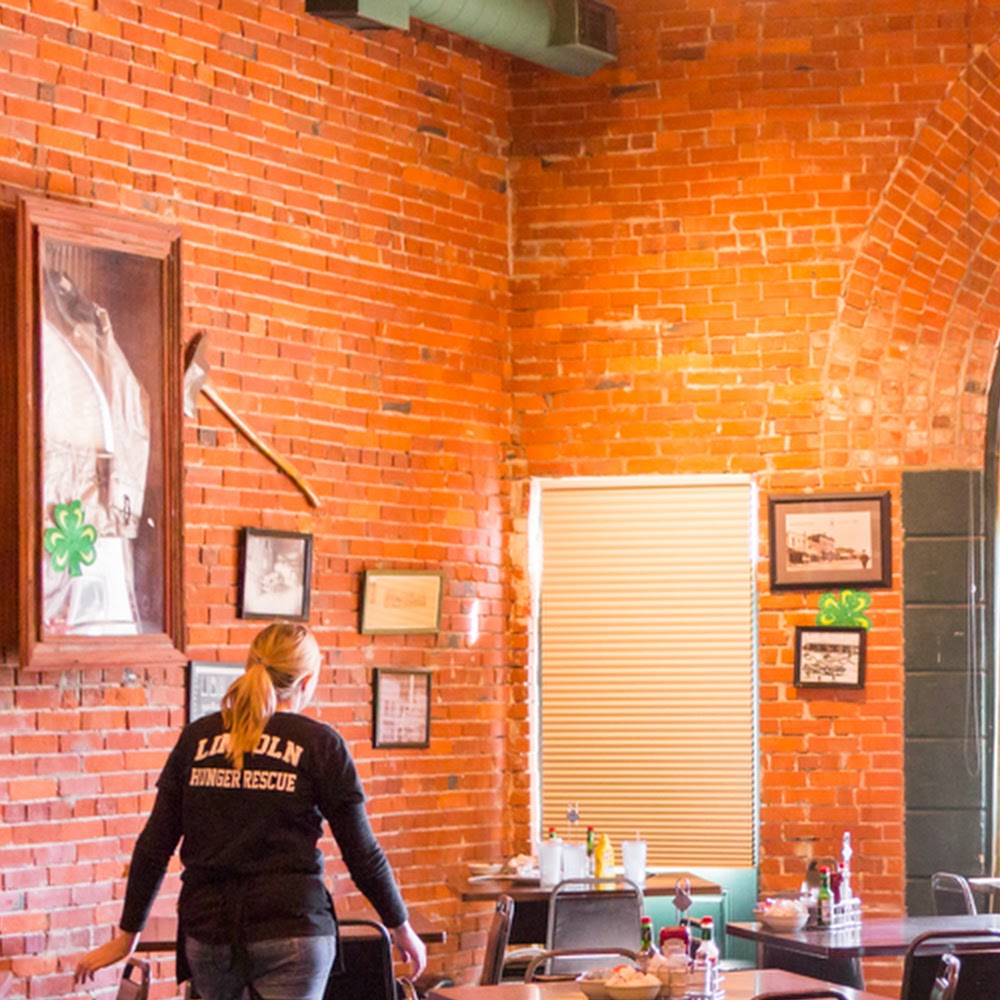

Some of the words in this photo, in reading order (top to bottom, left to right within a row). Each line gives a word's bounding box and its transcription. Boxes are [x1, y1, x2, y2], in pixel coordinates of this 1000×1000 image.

[194, 732, 304, 767] LINOLN
[189, 767, 241, 788] HUNGER
[242, 769, 297, 792] RESCUE
